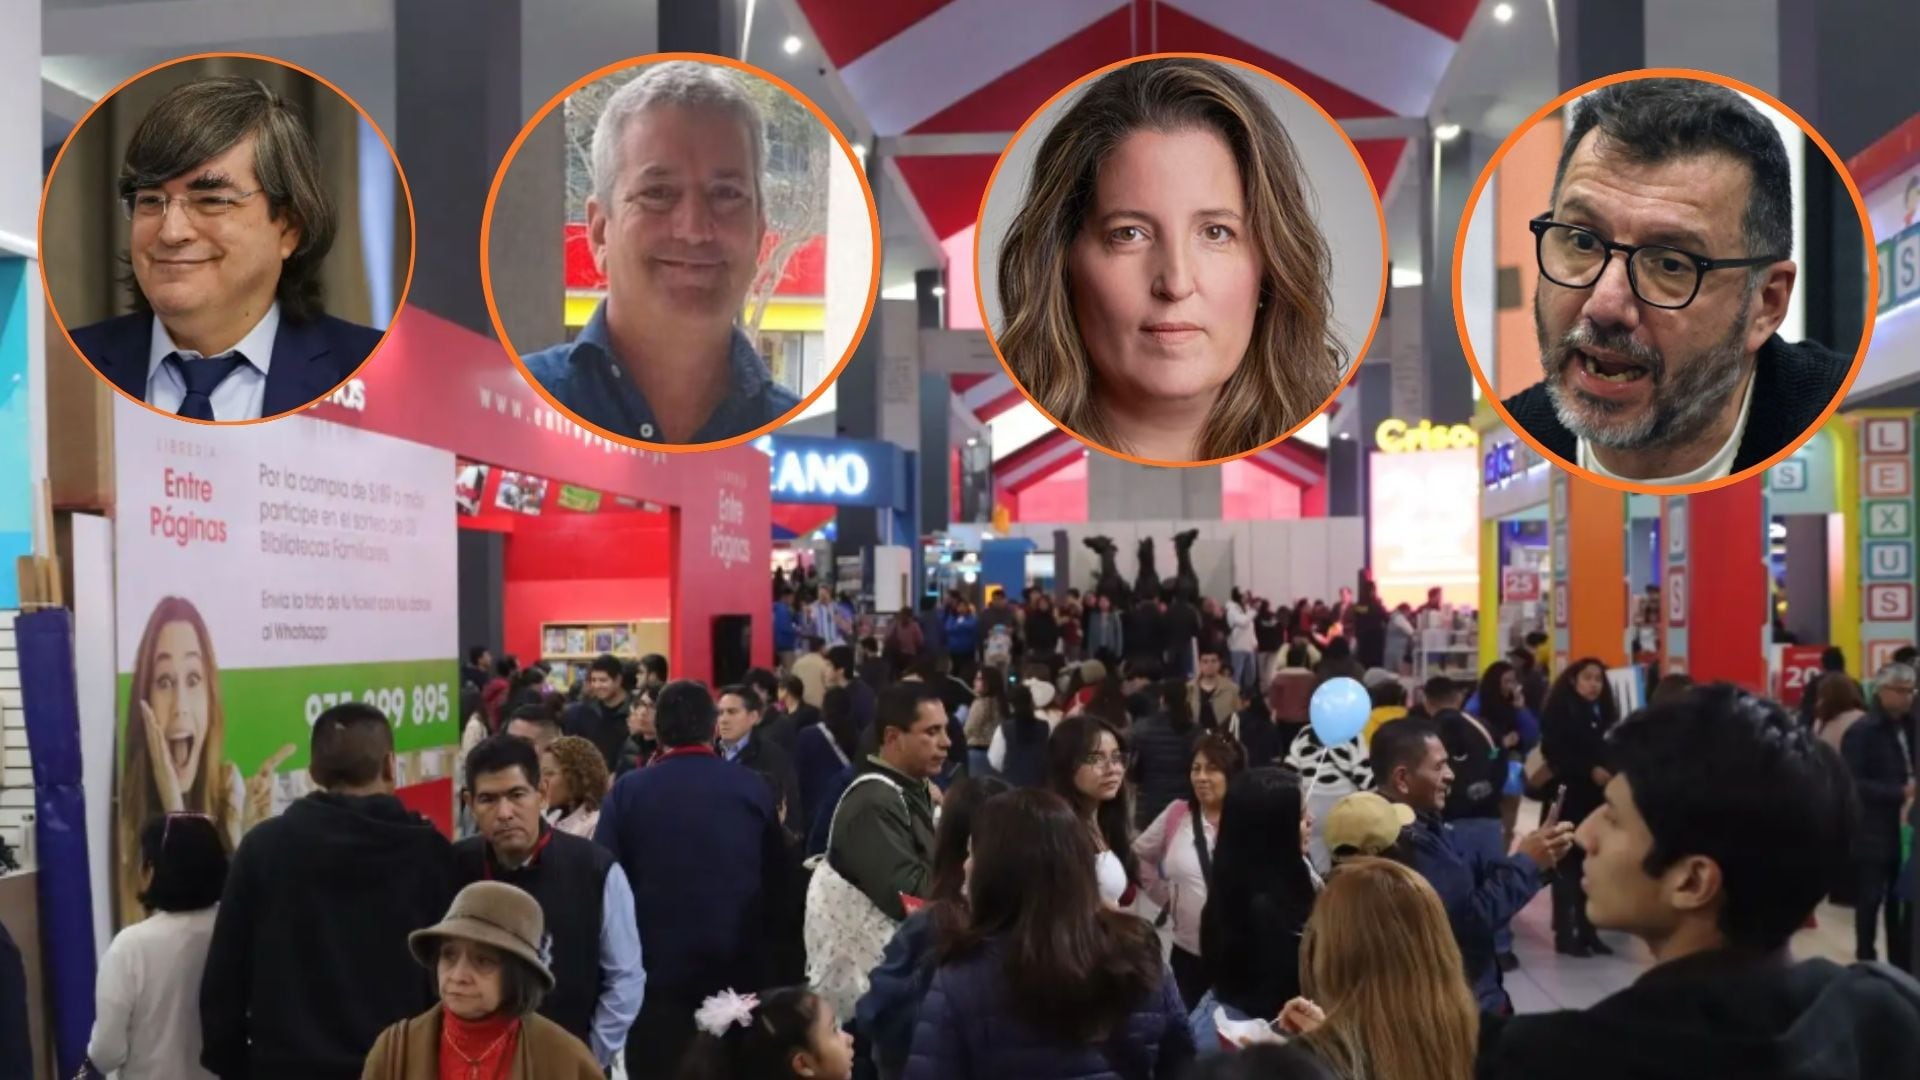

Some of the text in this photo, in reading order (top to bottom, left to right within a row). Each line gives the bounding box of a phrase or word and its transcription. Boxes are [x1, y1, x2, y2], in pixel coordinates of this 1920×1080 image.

[1375, 418, 1479, 452] Criso
[164, 467, 213, 502] Entre
[259, 462, 281, 488] Por
[284, 465, 297, 491] la
[300, 475, 349, 500] compra
[769, 450, 869, 497] ANO
[150, 505, 228, 547] Páginas
[259, 501, 319, 525] participe
[321, 509, 337, 527] en
[260, 530, 330, 558] Bibliotecas
[1508, 574, 1533, 593] 25
[412, 683, 449, 725] 895
